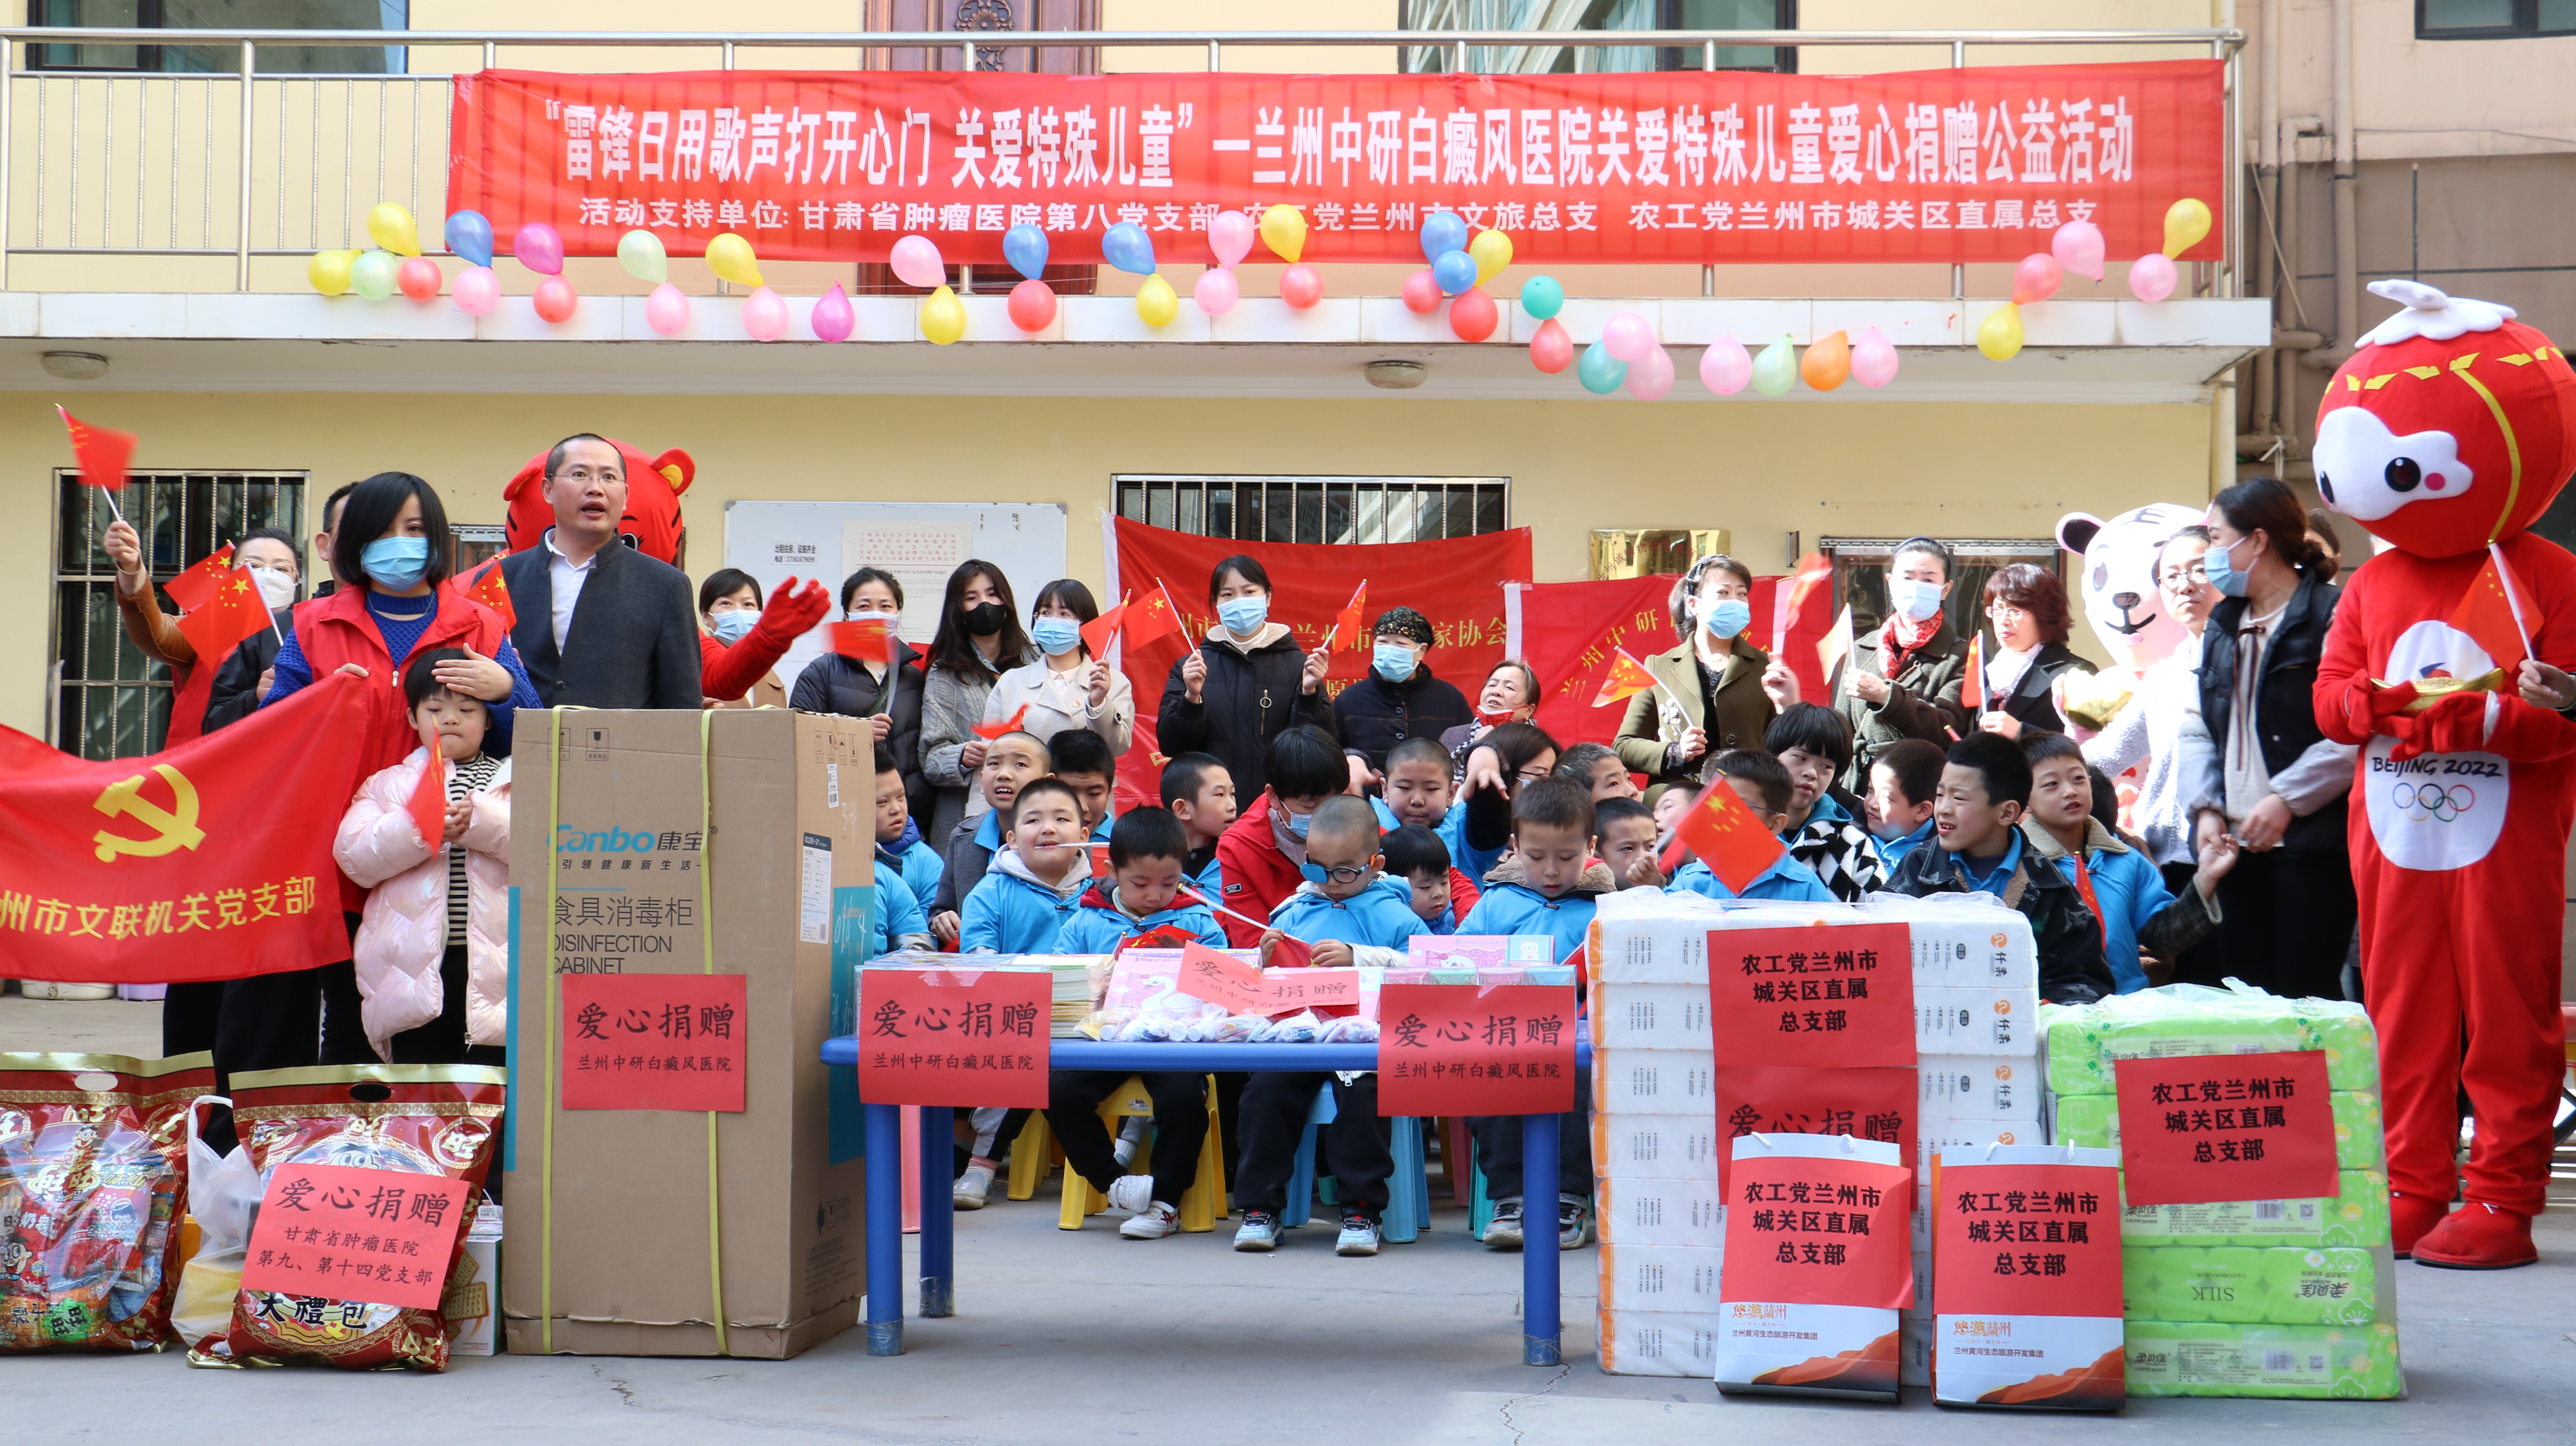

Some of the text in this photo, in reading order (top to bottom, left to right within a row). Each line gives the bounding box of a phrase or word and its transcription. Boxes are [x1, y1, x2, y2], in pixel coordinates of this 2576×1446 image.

[951, 103, 1193, 188] 关爱特殊儿童”
[1243, 201, 1597, 231] 农党兰州文旅总支
[1630, 199, 2097, 232] 农工党兰州市城关区直属总支
[2372, 757, 2504, 778] BEIJING 2022
[1741, 950, 1878, 977] 农工党兰州市
[1195, 960, 1347, 998] 爱心捐赠
[1753, 977, 1868, 1004] 城关区直属
[576, 1002, 735, 1041] 爱心捐赠
[872, 999, 1039, 1038] 爱心捐赠
[1392, 1014, 1563, 1049] 爱心捐赠
[1778, 1009, 1847, 1033] 总支部
[577, 1054, 732, 1072] 兰州中研白癜风医院
[872, 1053, 1034, 1071] 兰州中研白癜风医院
[1394, 1062, 1559, 1083] 兰州中研白癜风医院
[2152, 1077, 2296, 1105] 农工党兰州市
[2165, 1106, 2286, 1133] 城关区直属
[2193, 1139, 2266, 1163] 总支部
[275, 1178, 450, 1228] 爱心捐赠
[1744, 1181, 1881, 1208] 农工党兰州市
[1956, 1191, 2099, 1215] 农工党兰州市
[1753, 1209, 1870, 1236] 城关区直属
[1968, 1221, 2089, 1244] 城关区直属
[285, 1226, 419, 1257] 甘肃省肿瘤医院
[1775, 1242, 1846, 1266] 总支部
[258, 1249, 433, 1287] 第九、第十四党支部
[1993, 1252, 2066, 1276] 总支部
[2191, 1286, 2234, 1302] SILK
[1732, 1329, 1818, 1340] 兰州黄河生态旅游开发集团
[1953, 1347, 2044, 1358] 兰州黄河生态旅游开发集团
